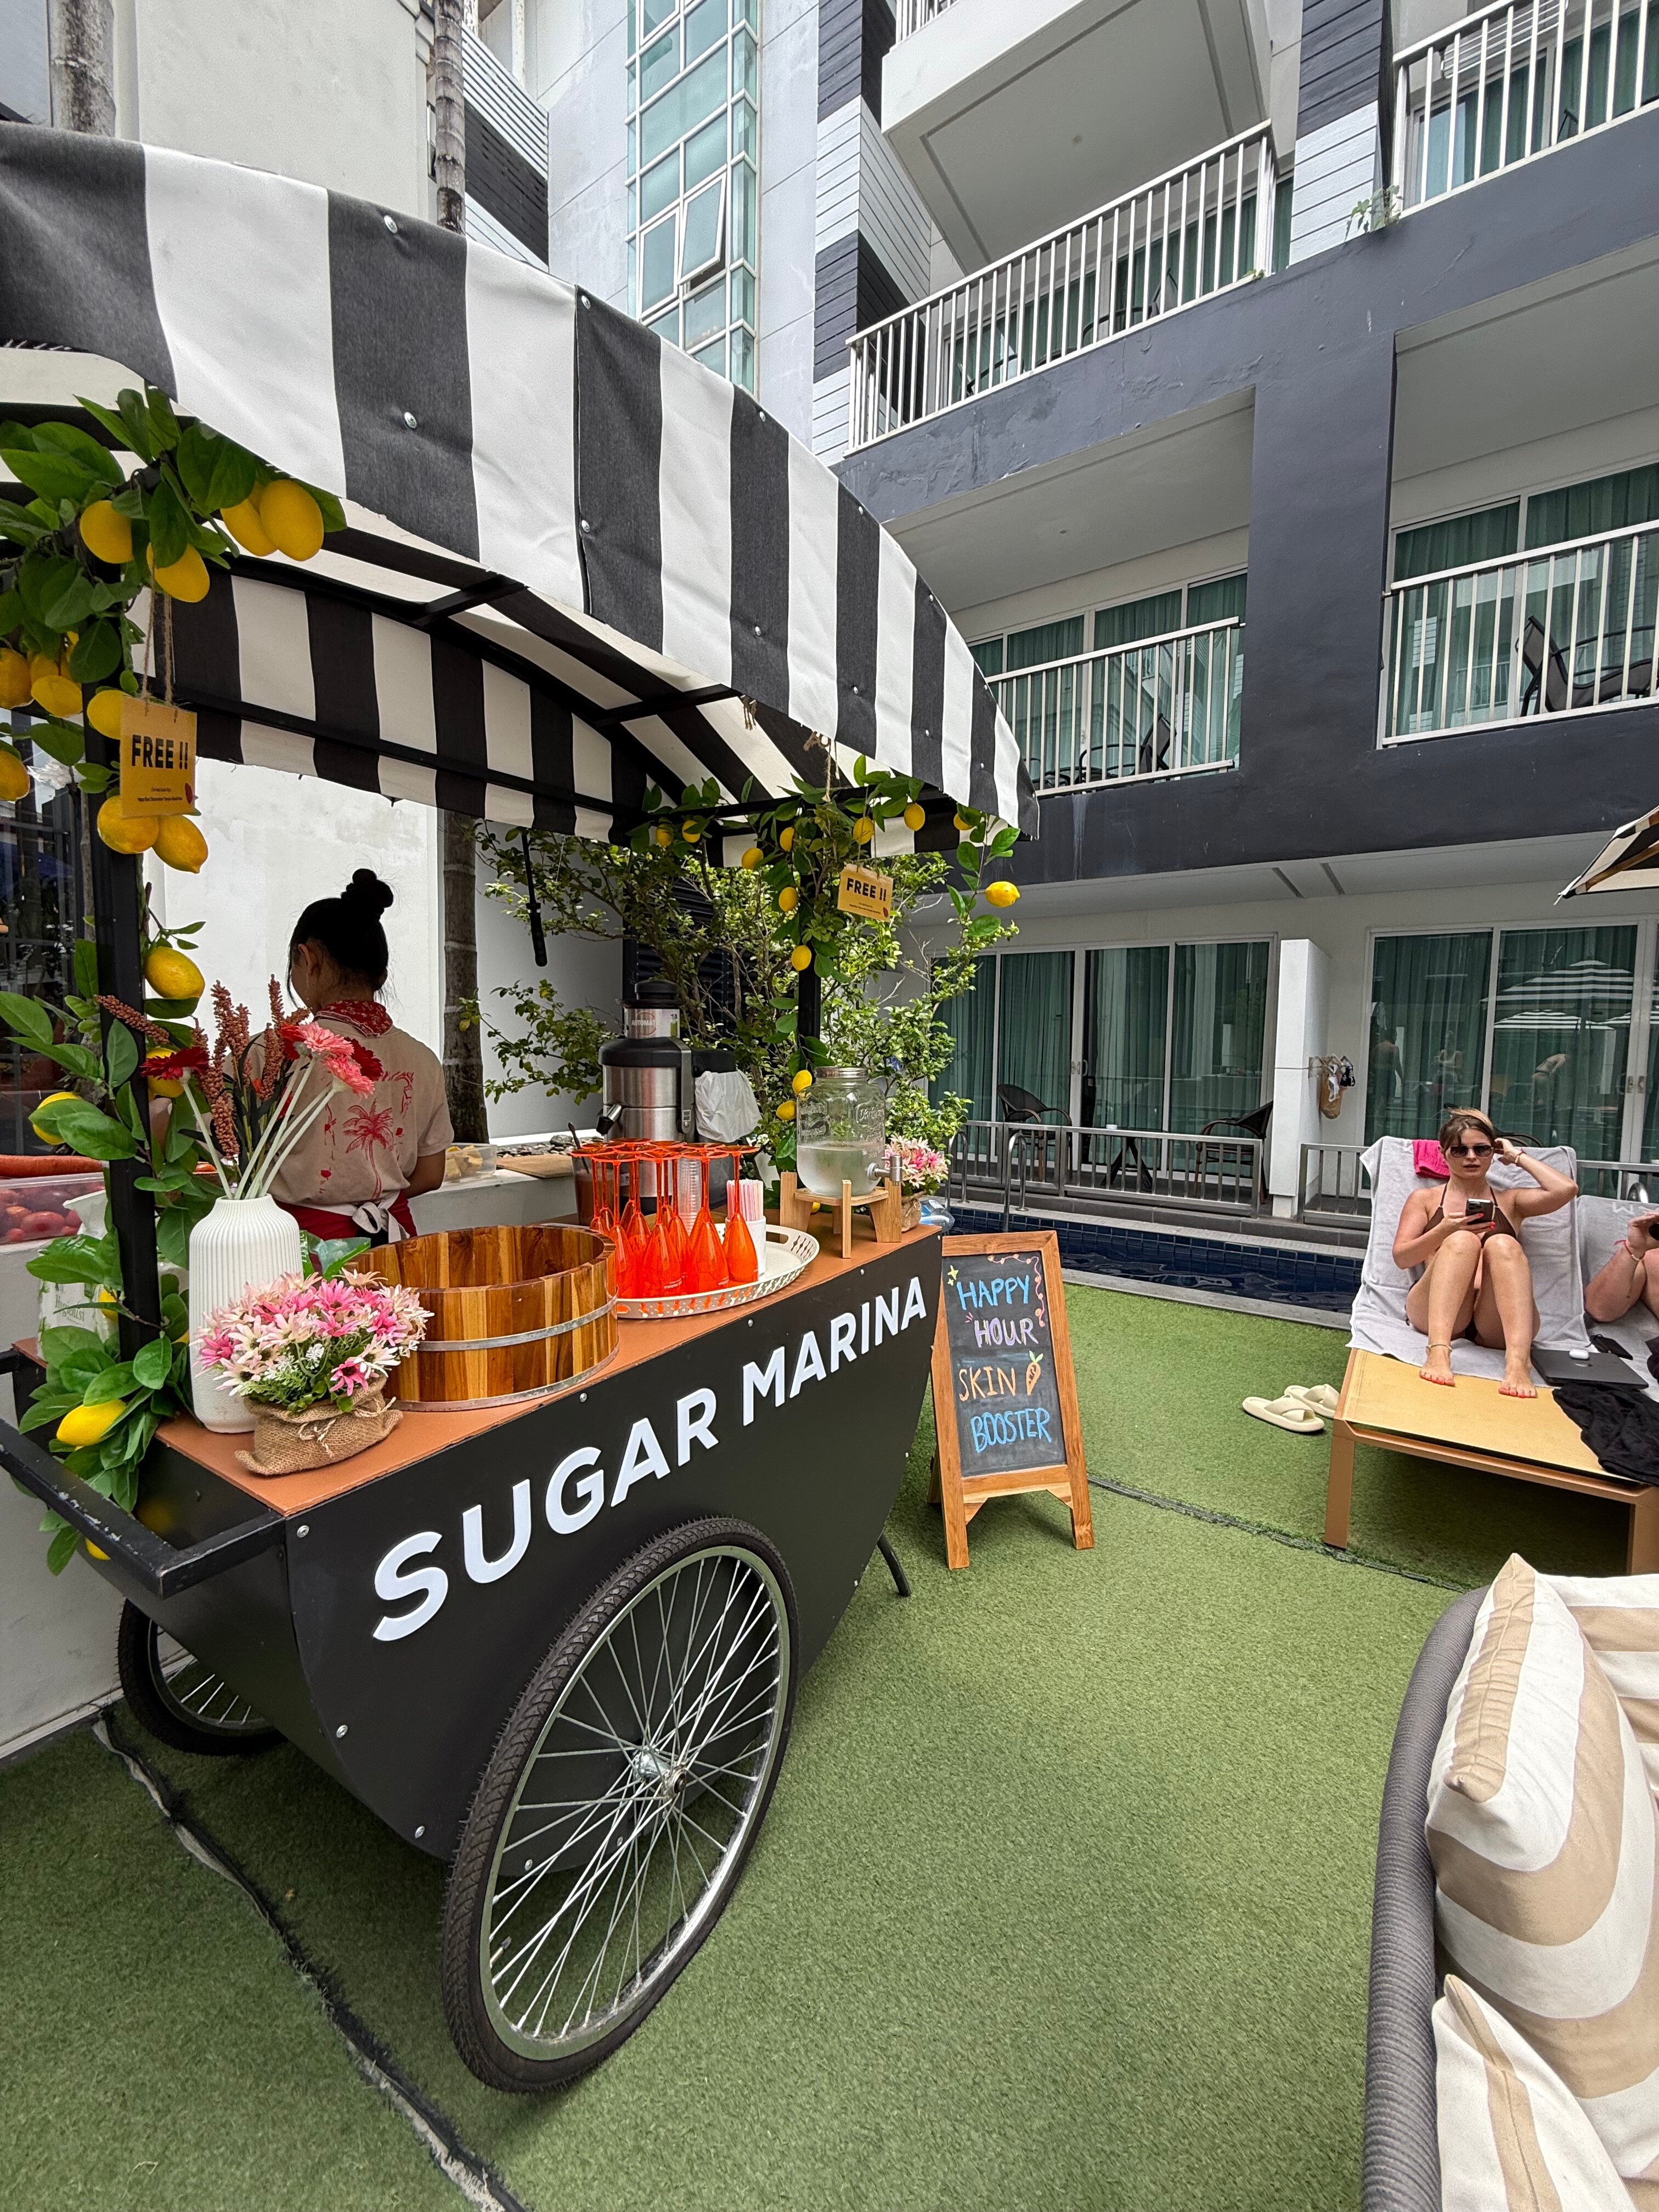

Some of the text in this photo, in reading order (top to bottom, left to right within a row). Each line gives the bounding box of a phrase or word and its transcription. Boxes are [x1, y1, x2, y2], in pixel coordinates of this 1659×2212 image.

[132, 734, 174, 769] FREE
[846, 878, 876, 899] FREE
[956, 1274, 1030, 1311] HAPPY
[973, 1318, 1039, 1348] HOUR
[958, 1365, 1016, 1401] SKIN
[970, 1407, 1052, 1454] BOOSTER
[372, 1276, 928, 1642] SUGAR MARINA
